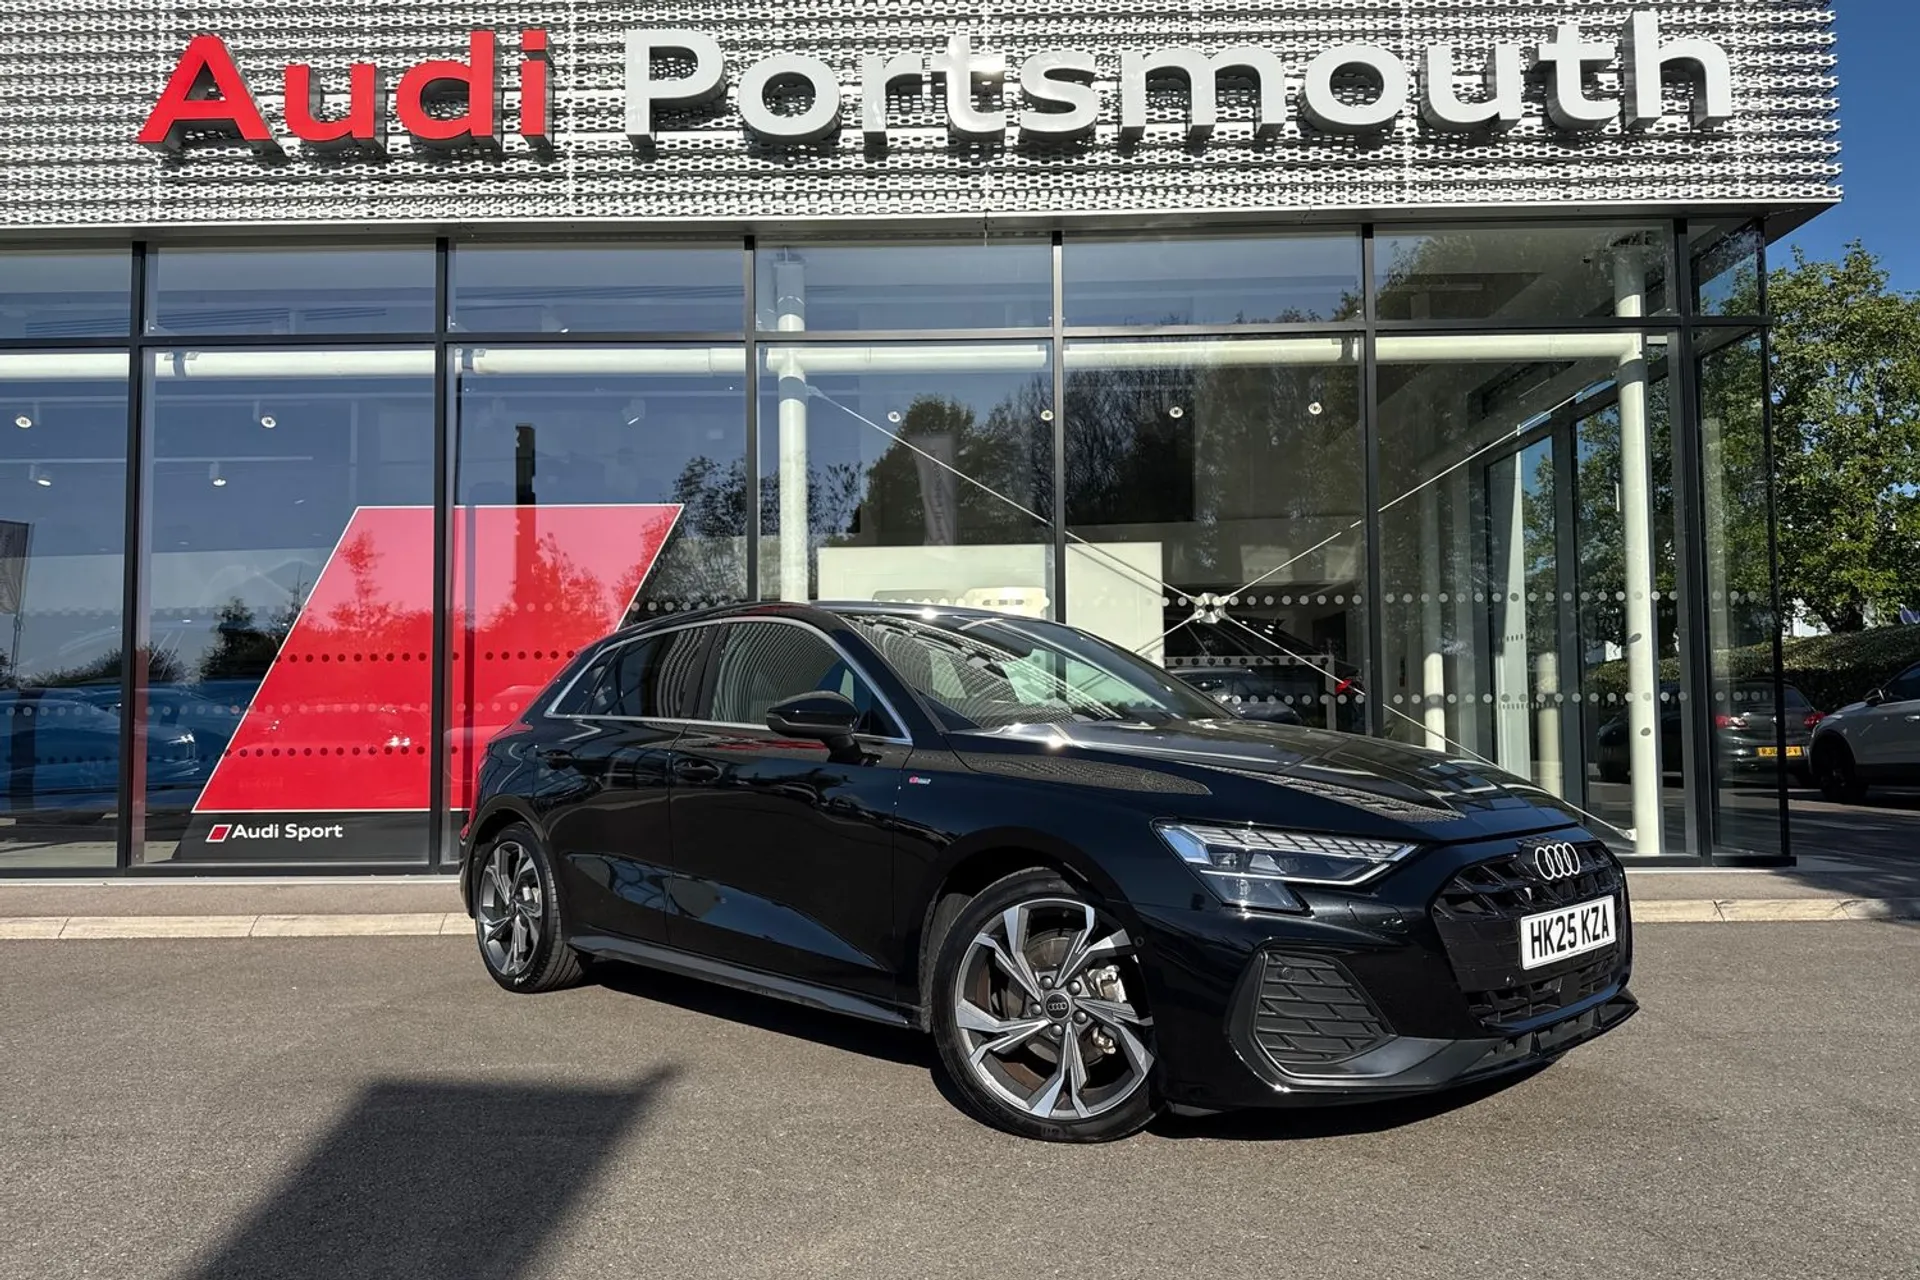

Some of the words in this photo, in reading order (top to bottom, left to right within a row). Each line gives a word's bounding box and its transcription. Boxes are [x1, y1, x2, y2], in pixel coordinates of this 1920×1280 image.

[137, 29, 550, 146] Audi
[624, 11, 1733, 139] Portsmouth
[231, 824, 279, 839] Audi
[285, 823, 343, 842] Sport
[1530, 912, 1577, 959] HK25
[1581, 903, 1609, 945] KZA
